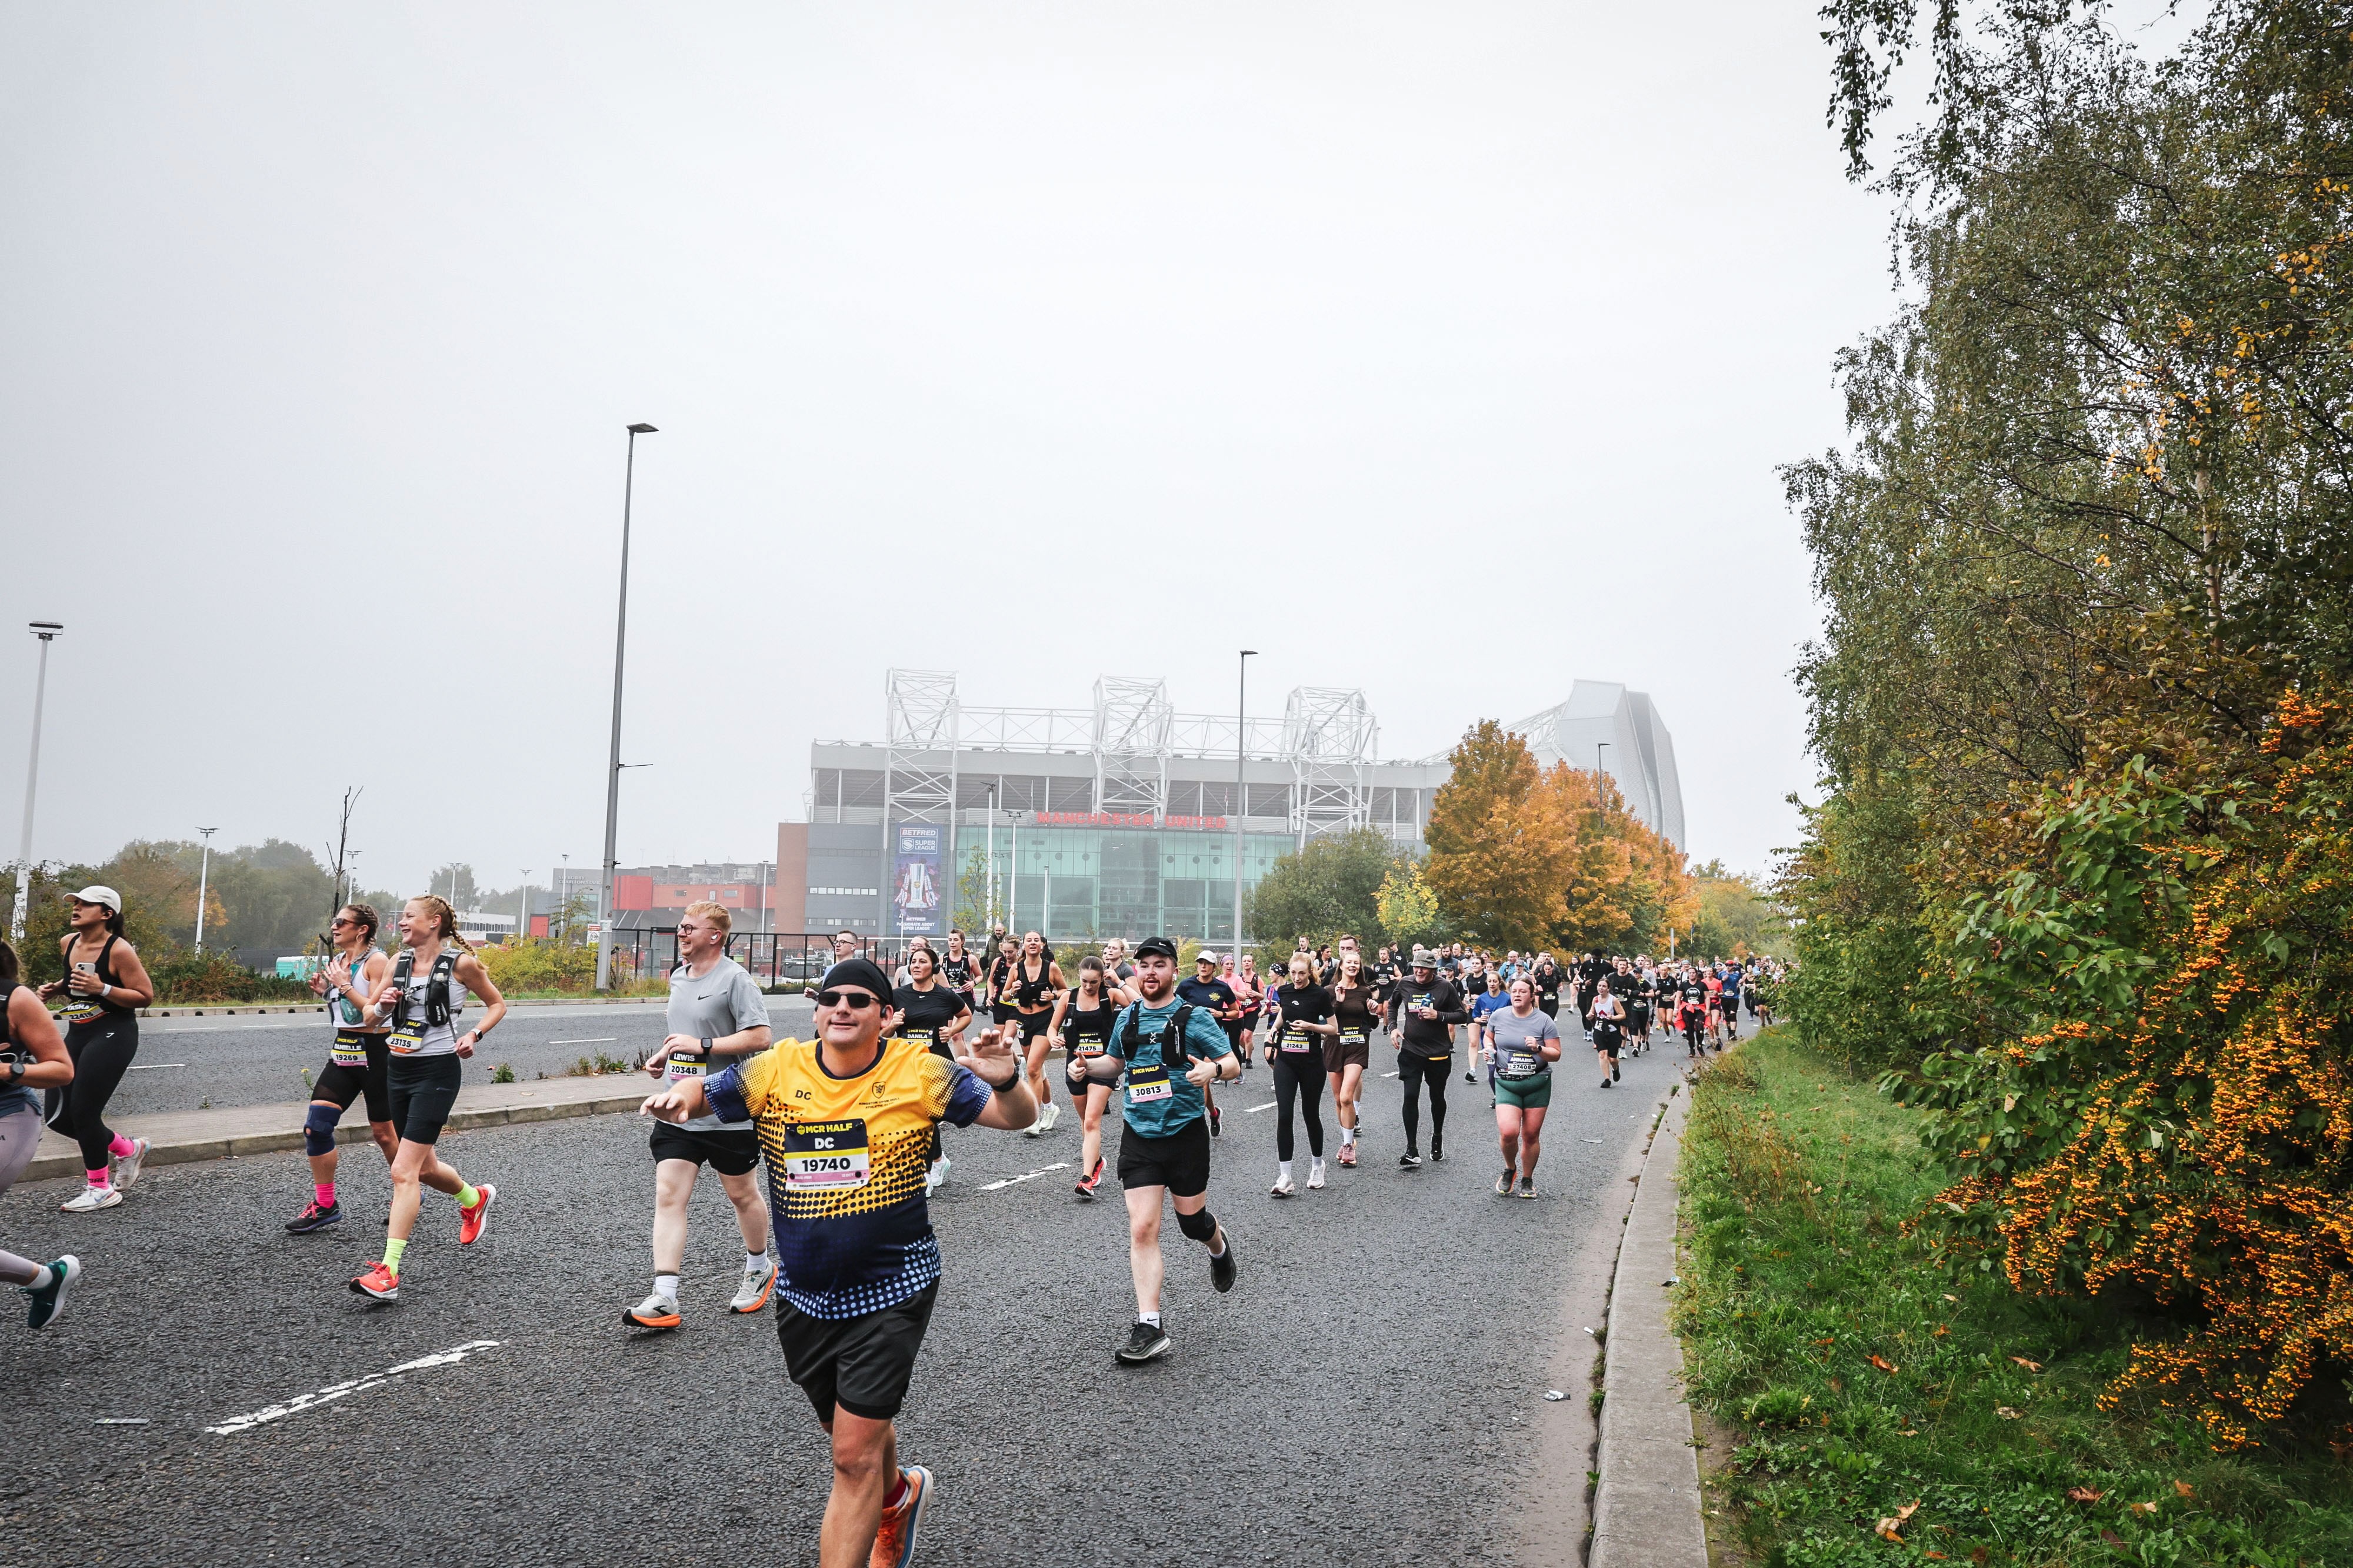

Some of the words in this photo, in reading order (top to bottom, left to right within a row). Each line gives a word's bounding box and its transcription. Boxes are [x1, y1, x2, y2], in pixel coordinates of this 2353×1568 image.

[1037, 812, 1154, 826] MANCHESTER
[1165, 815, 1227, 829] UNITED
[390, 1038, 411, 1047] 23135
[674, 1053, 695, 1062] LEWIS
[671, 1066, 697, 1075] 20348
[795, 1090, 812, 1100] DC
[1136, 1086, 1161, 1096] 30813
[805, 1125, 825, 1133] MCR
[826, 1123, 852, 1132] HALF
[815, 1137, 834, 1149] DC
[802, 1157, 851, 1172] 19740
